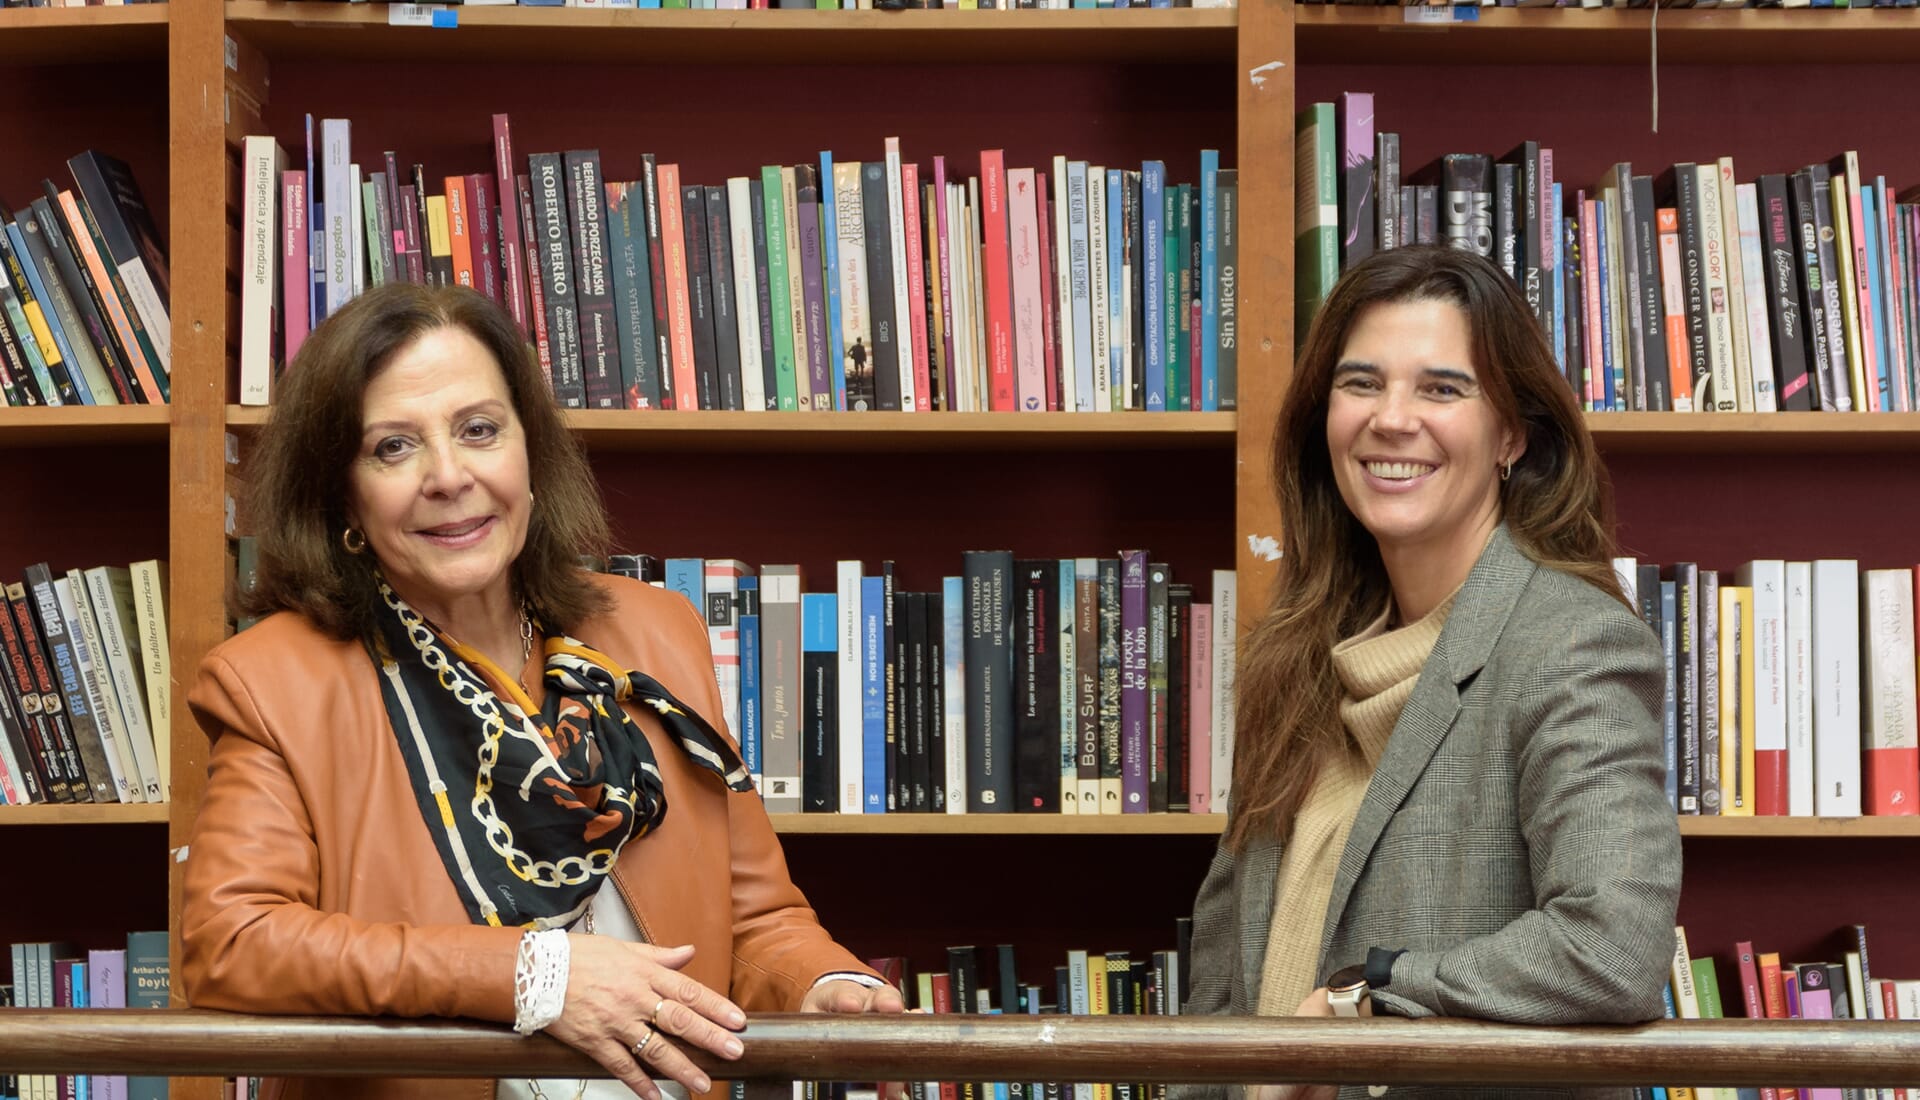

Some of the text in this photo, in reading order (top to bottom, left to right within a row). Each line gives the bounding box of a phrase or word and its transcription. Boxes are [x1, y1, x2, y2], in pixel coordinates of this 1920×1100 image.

[257, 157, 270, 216] Inteligencia
[1771, 197, 1782, 213] LIZ
[542, 165, 566, 295] ROBERTO BERRO
[582, 162, 604, 295] BERNARDO PORZECANSKI
[838, 187, 857, 240] JEFFREY
[849, 186, 863, 247] ARCHER
[1072, 198, 1084, 224] KEATON
[1773, 215, 1786, 243] PHAIR
[256, 227, 267, 285] aprendizaje
[1072, 239, 1084, 261] AHORA
[1148, 220, 1157, 259] DOCENTES
[1802, 223, 1815, 251] CERO
[1148, 261, 1157, 282] PARA
[1805, 252, 1816, 265] AL
[581, 266, 592, 295] Uruguay
[1073, 269, 1086, 300] SIEMPRE
[1688, 249, 1701, 312] CONOCER
[1808, 267, 1821, 291] UNO
[1220, 265, 1235, 348] Sin Miedo
[1693, 316, 1702, 331] AL
[1814, 308, 1824, 335] SILVIA
[1825, 279, 1845, 356] Lovebook
[594, 313, 604, 342] Antonio
[1149, 311, 1157, 365] COMPUTACIÓN
[8, 343, 24, 370] JAMES
[597, 353, 606, 377] Turnes
[1694, 335, 1705, 376] DIEGO
[1817, 336, 1829, 371] PASTOR
[82, 611, 94, 639] Guerra
[93, 575, 122, 657] Demonios íntimos
[141, 569, 162, 675] Un adúltero americano
[972, 576, 981, 638] LOS ÚLTIMOS
[982, 581, 991, 633] ESPAÑOLES
[993, 568, 1002, 646] DE MAUTHAUSEN
[90, 641, 104, 672] Tercera
[869, 615, 877, 682] MERCEDES RON
[1122, 629, 1134, 688] La noche
[1134, 626, 1147, 690] de la loba
[100, 673, 108, 686] La
[985, 693, 991, 703] DE
[1082, 606, 1096, 766] BODY SURF ANITA
[71, 693, 88, 716] JEFF
[747, 699, 756, 769] CARLOS BALMACEDA
[984, 704, 992, 746] HERNÁNDEZ
